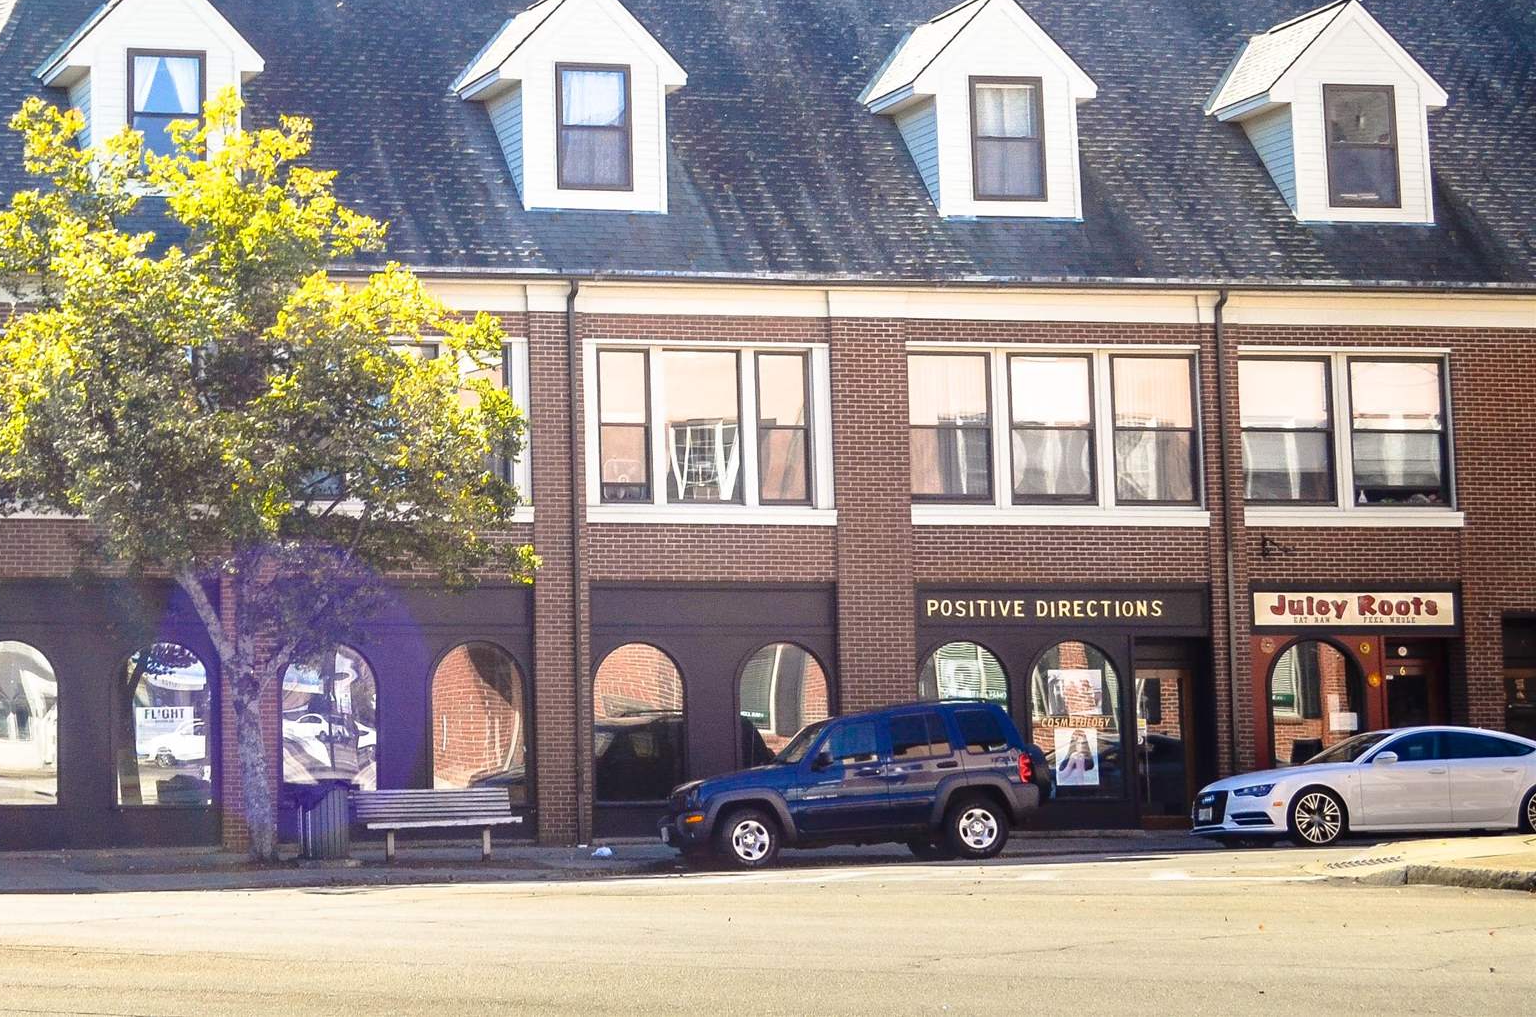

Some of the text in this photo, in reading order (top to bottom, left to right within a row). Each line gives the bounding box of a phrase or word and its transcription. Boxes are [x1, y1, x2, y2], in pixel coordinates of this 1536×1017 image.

[926, 599, 1163, 618] POSITIVE DIRECTIONS
[1357, 594, 1439, 616] Roots
[1399, 666, 1406, 676] 6
[1041, 717, 1111, 729] COSMETOLOGY
